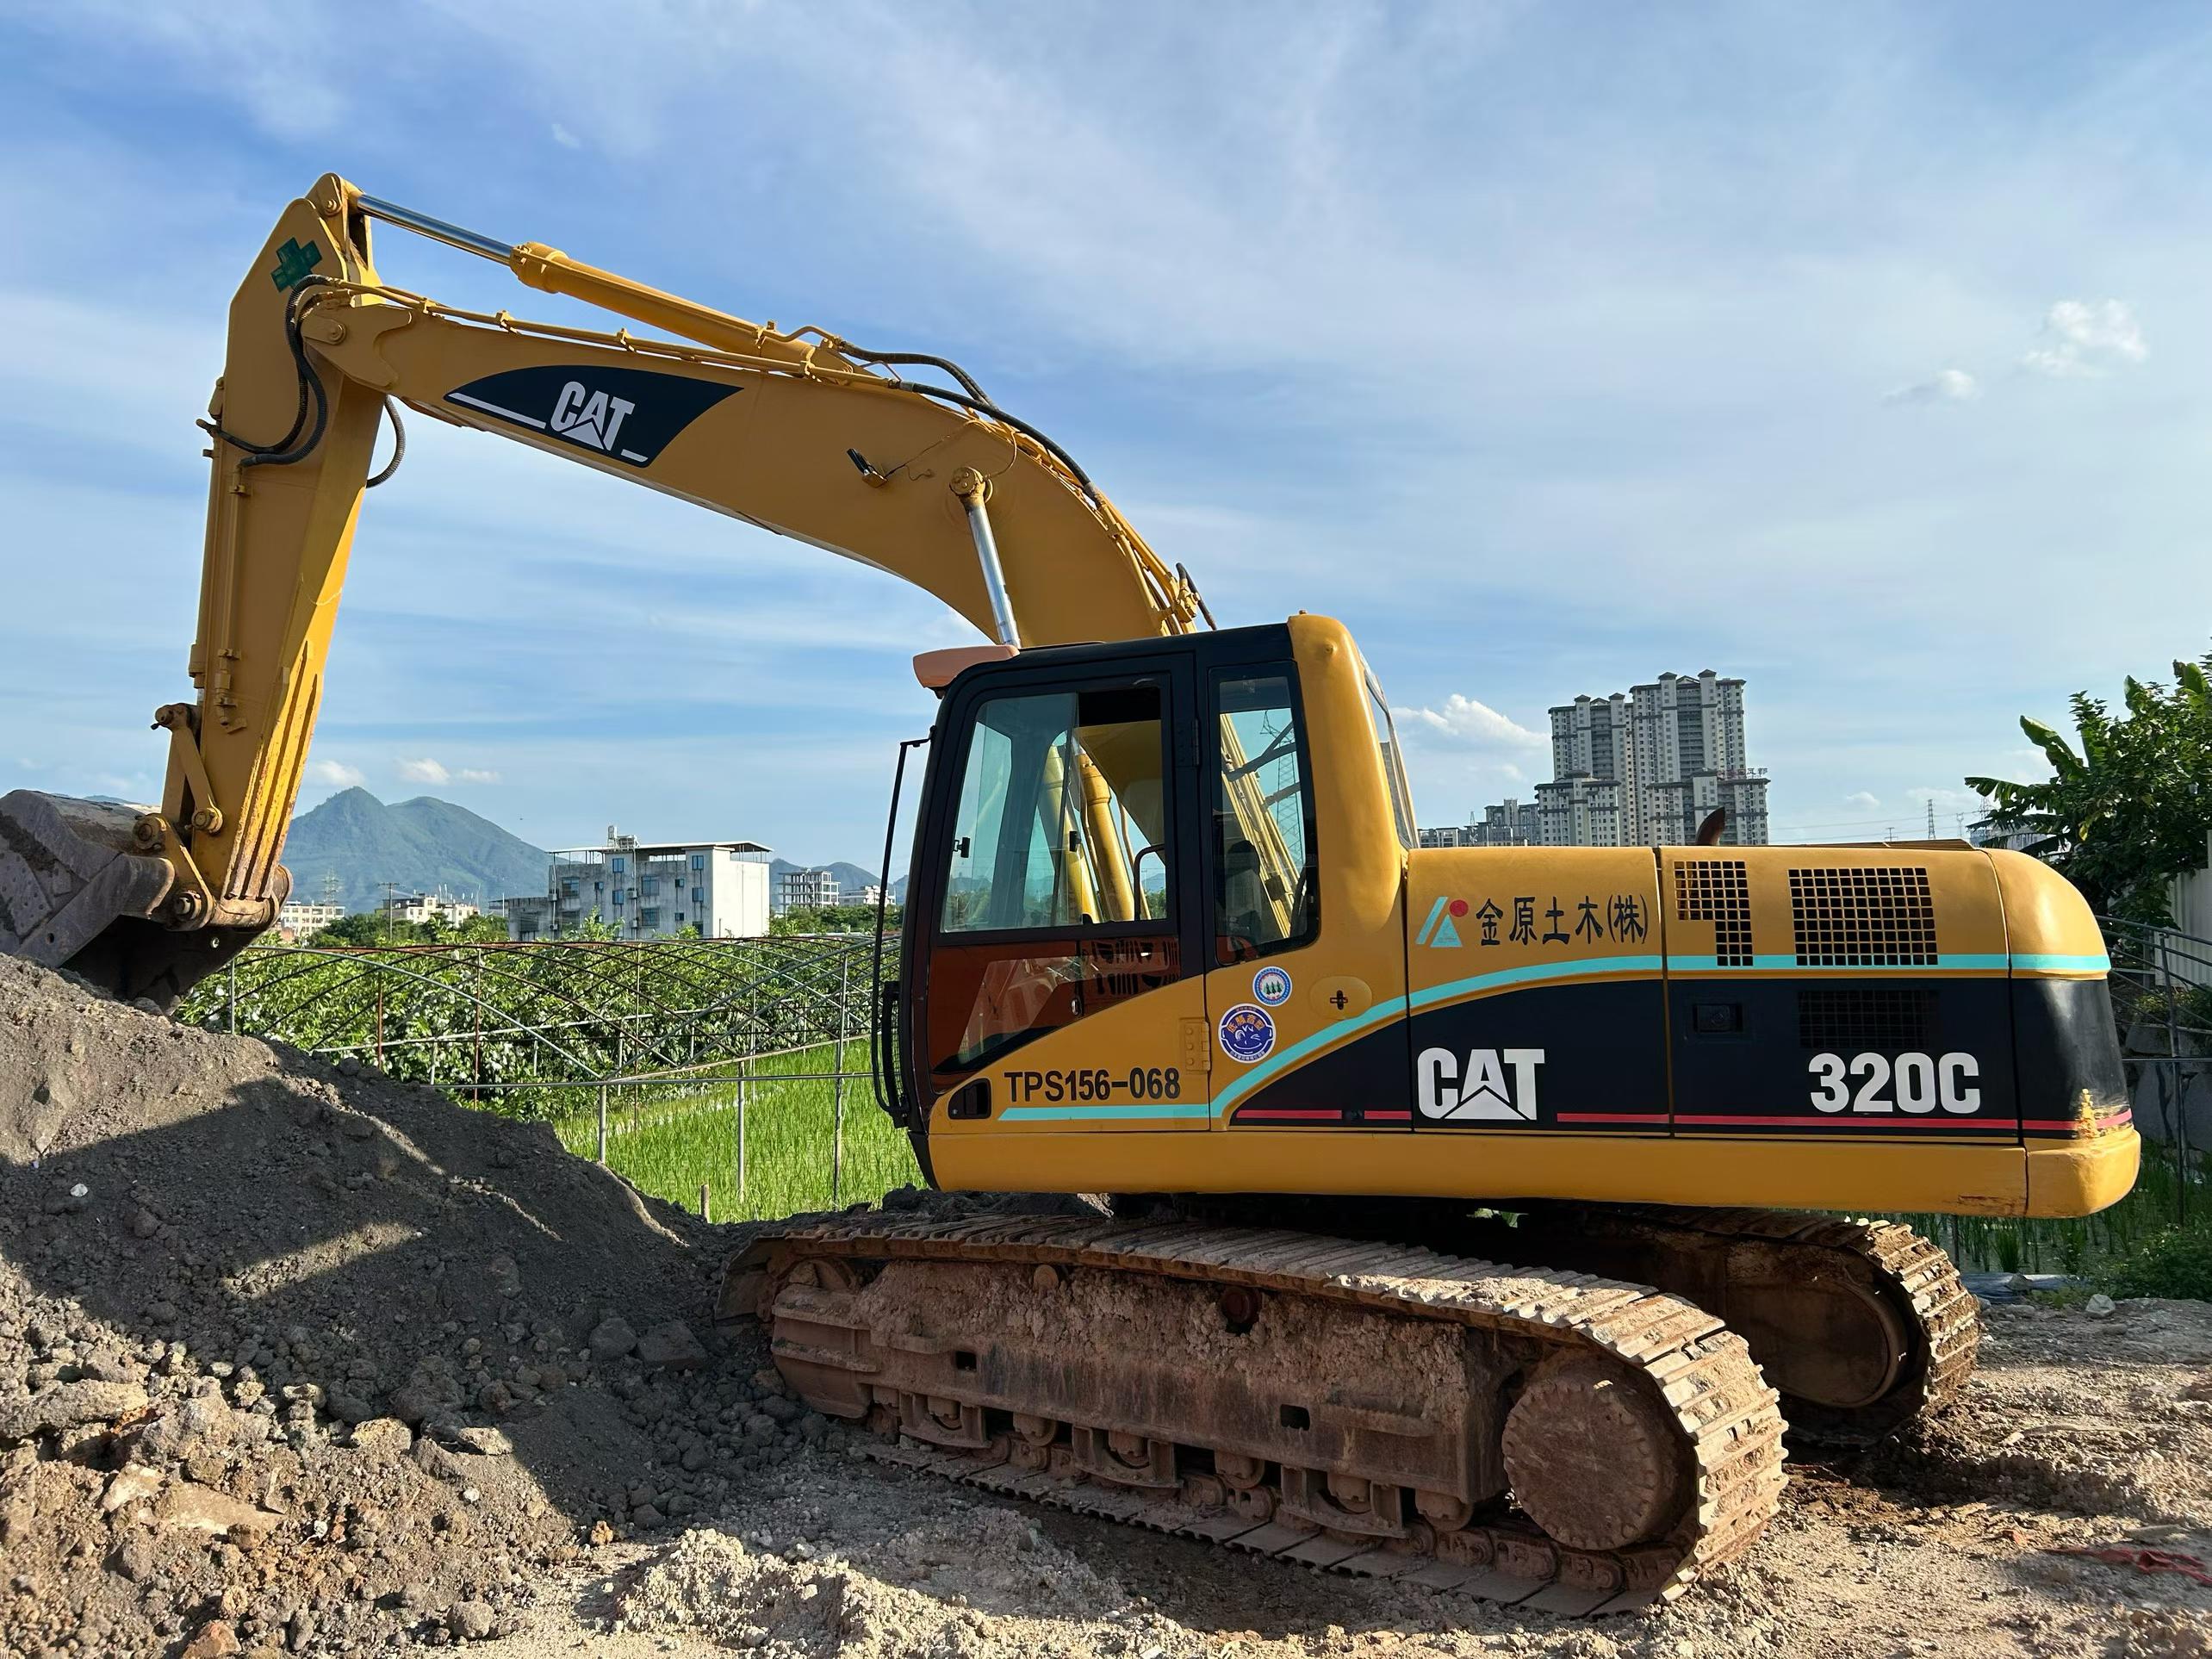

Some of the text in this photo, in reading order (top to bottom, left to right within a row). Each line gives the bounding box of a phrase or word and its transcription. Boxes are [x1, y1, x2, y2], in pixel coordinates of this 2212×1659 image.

[550, 382, 636, 451] CAT
[1476, 894, 1649, 947] 金原土木(株)
[1004, 1067, 1181, 1103] TPS156-068
[1417, 1047, 1545, 1121] CAT
[1809, 1052, 1981, 1114] 320C
